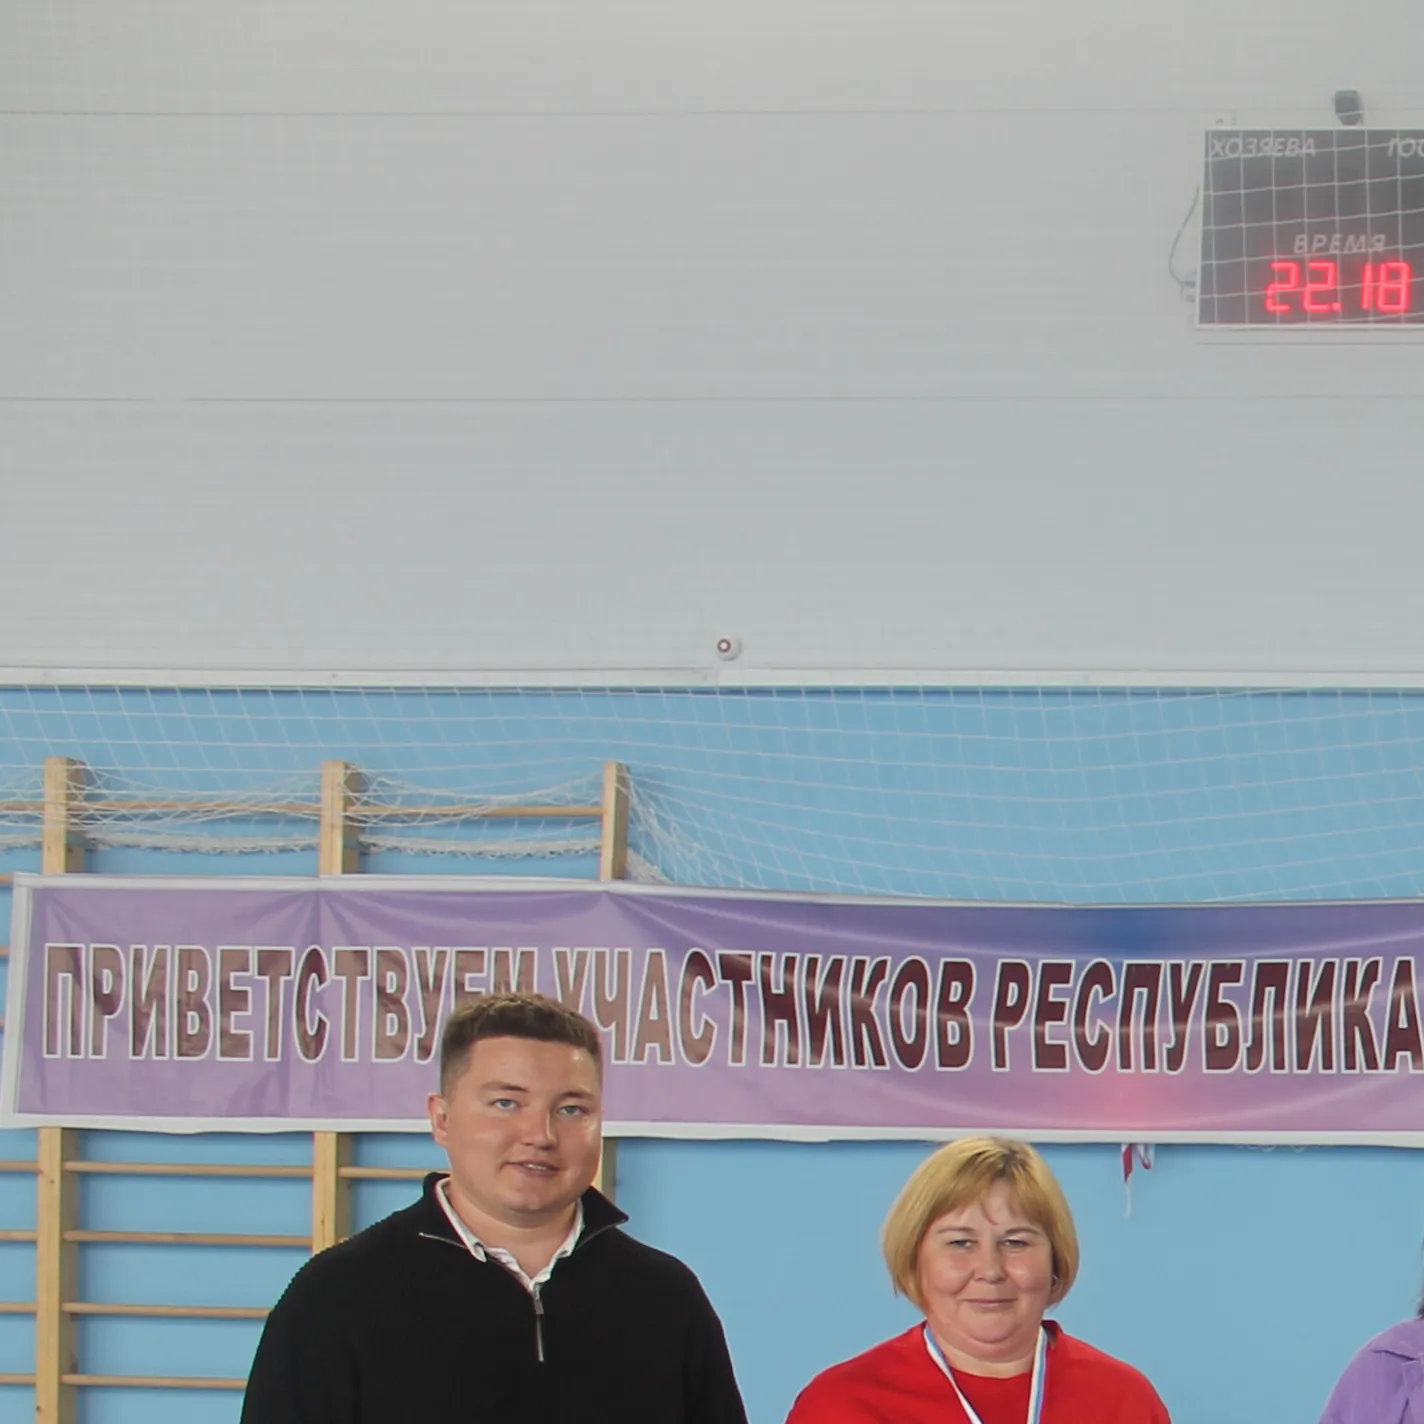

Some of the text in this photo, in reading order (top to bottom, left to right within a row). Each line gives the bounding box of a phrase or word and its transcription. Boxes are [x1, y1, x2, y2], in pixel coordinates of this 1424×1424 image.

[1211, 138, 1316, 158] ХОЗЯЕВА
[1294, 234, 1386, 254] ВРЕМЯ
[1265, 261, 1411, 313] 22.18
[552, 947, 976, 1071] УЧАСТНИКОВ
